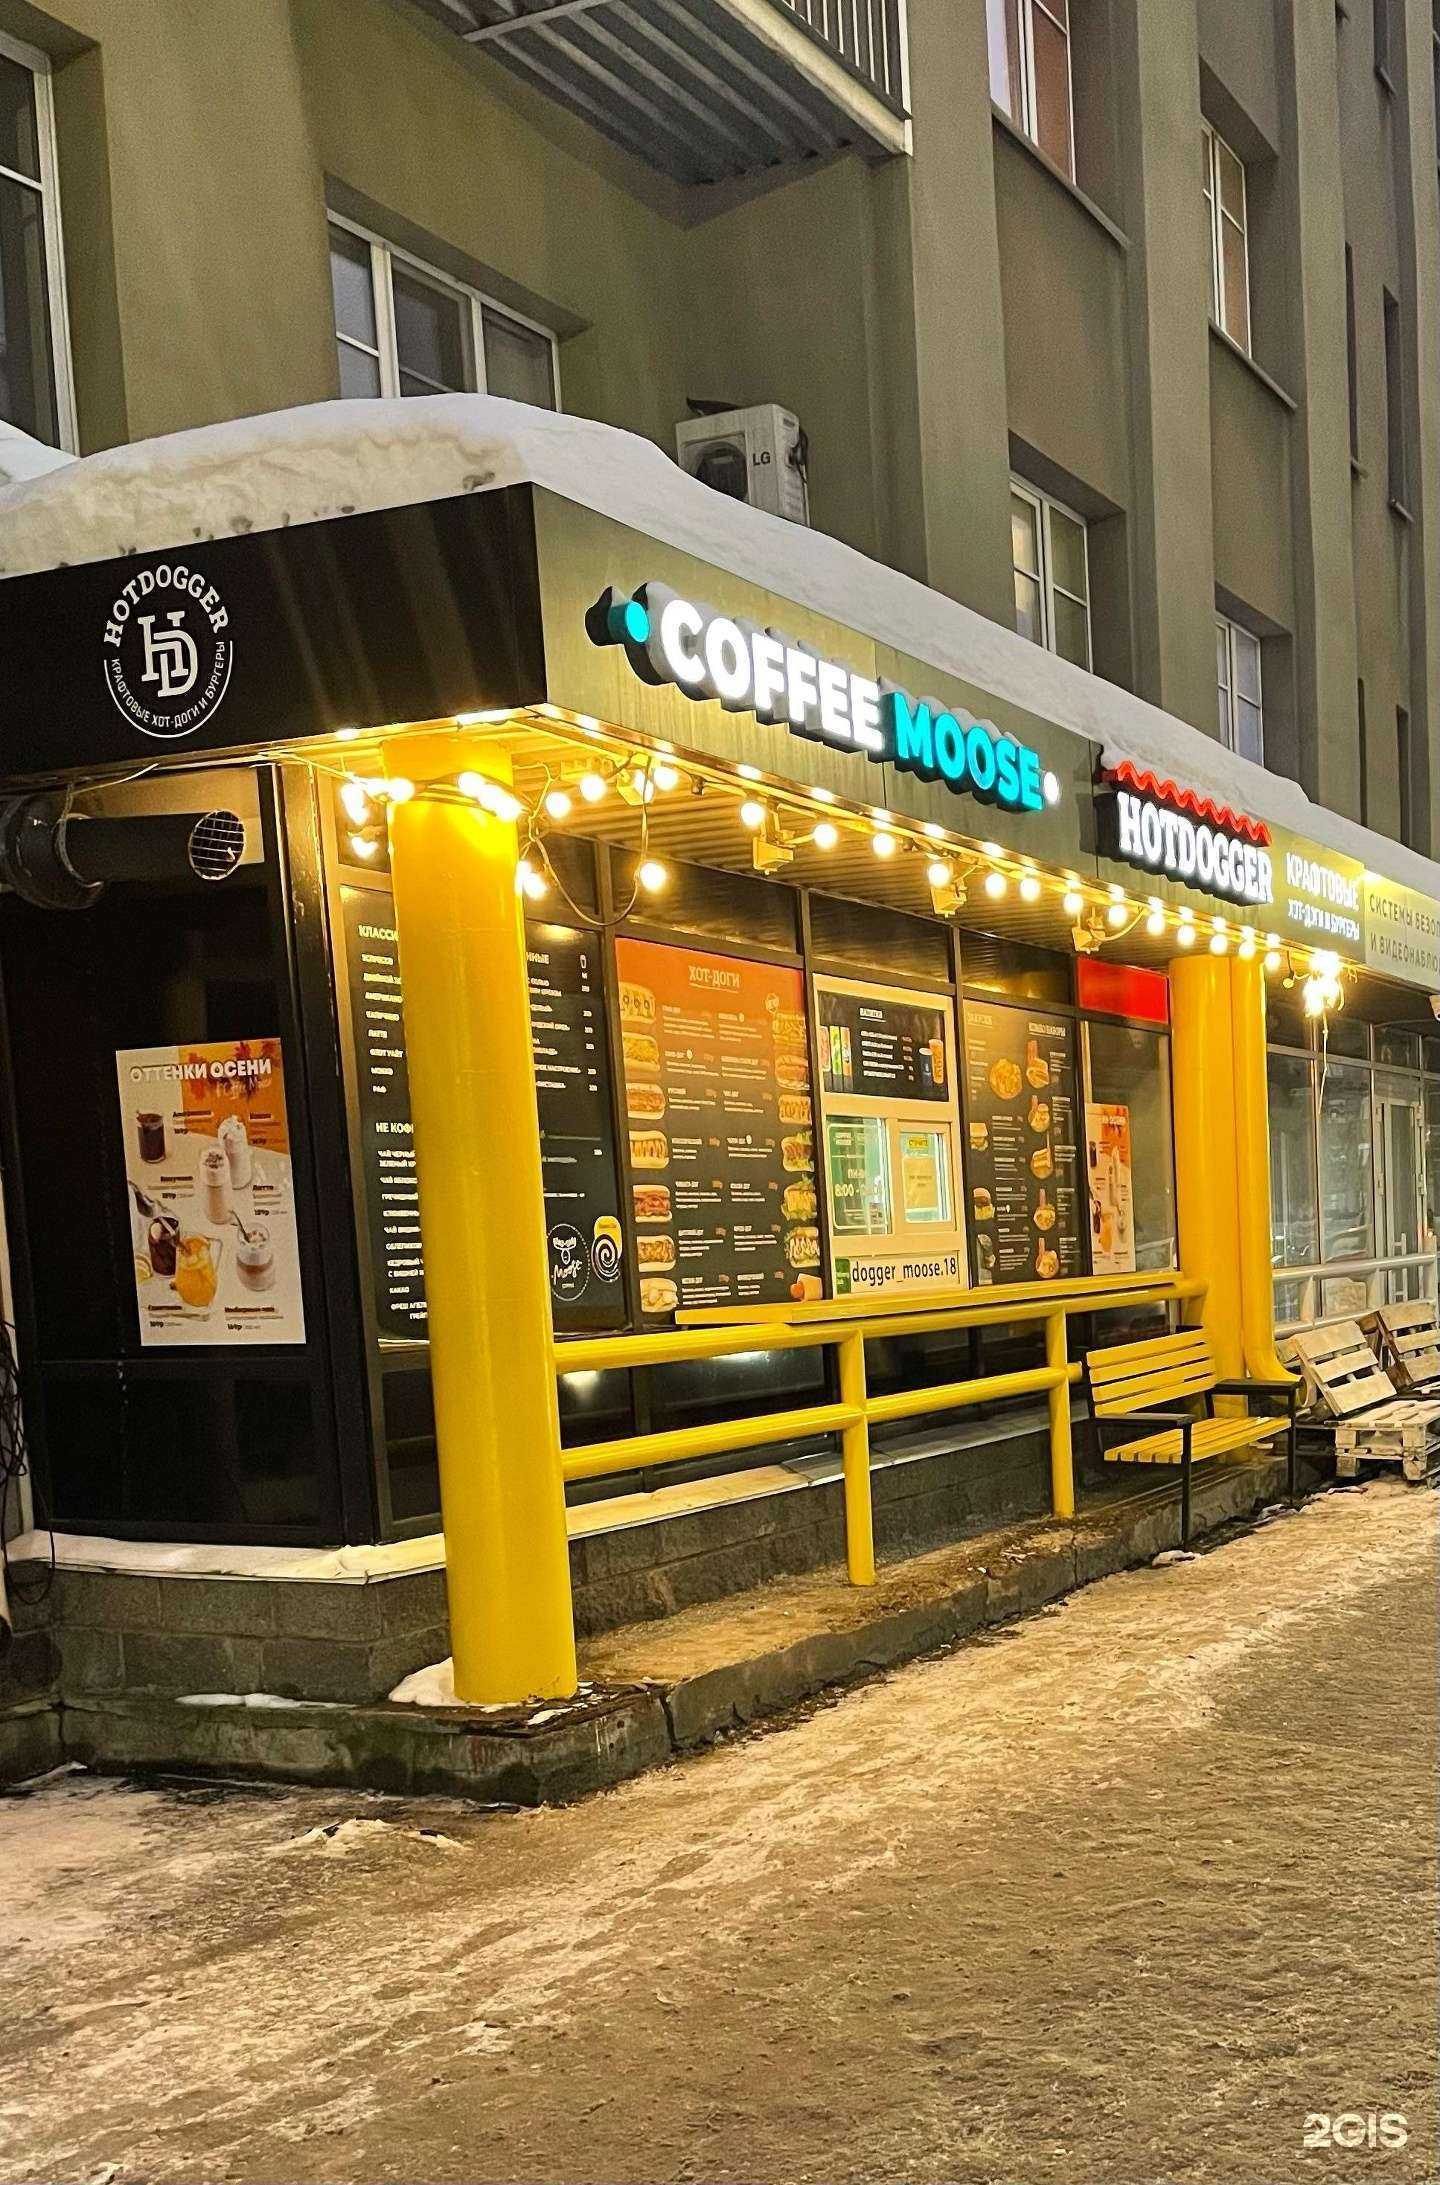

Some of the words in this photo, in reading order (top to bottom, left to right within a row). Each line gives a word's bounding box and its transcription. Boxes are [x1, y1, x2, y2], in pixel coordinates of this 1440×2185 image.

[752, 451, 771, 466] LG
[103, 564, 229, 647] HOTDOGGER
[111, 658, 151, 723] КРАФТОВЫЕ
[151, 707, 200, 729] ХОТ-ДОГИ
[199, 699, 208, 709] И
[204, 641, 225, 699] БУРГЕРЫ
[660, 599, 884, 752] COFFEE
[893, 692, 1045, 812] MOOSE
[1116, 790, 1274, 904] HOTDOGGER
[1369, 894, 1413, 927] СИСТЕМЫ
[1370, 931, 1377, 952] И
[1380, 935, 1440, 977] ВИДЕОНАБЛЮ
[688, 965, 741, 988] ХОТ-ДОГИ
[130, 1063, 208, 1082] ОТТЕНКИ
[210, 1058, 272, 1078] ОСЕНИ
[376, 1122, 390, 1133] НЕ
[852, 1257, 957, 1286] dogger_moose.18
